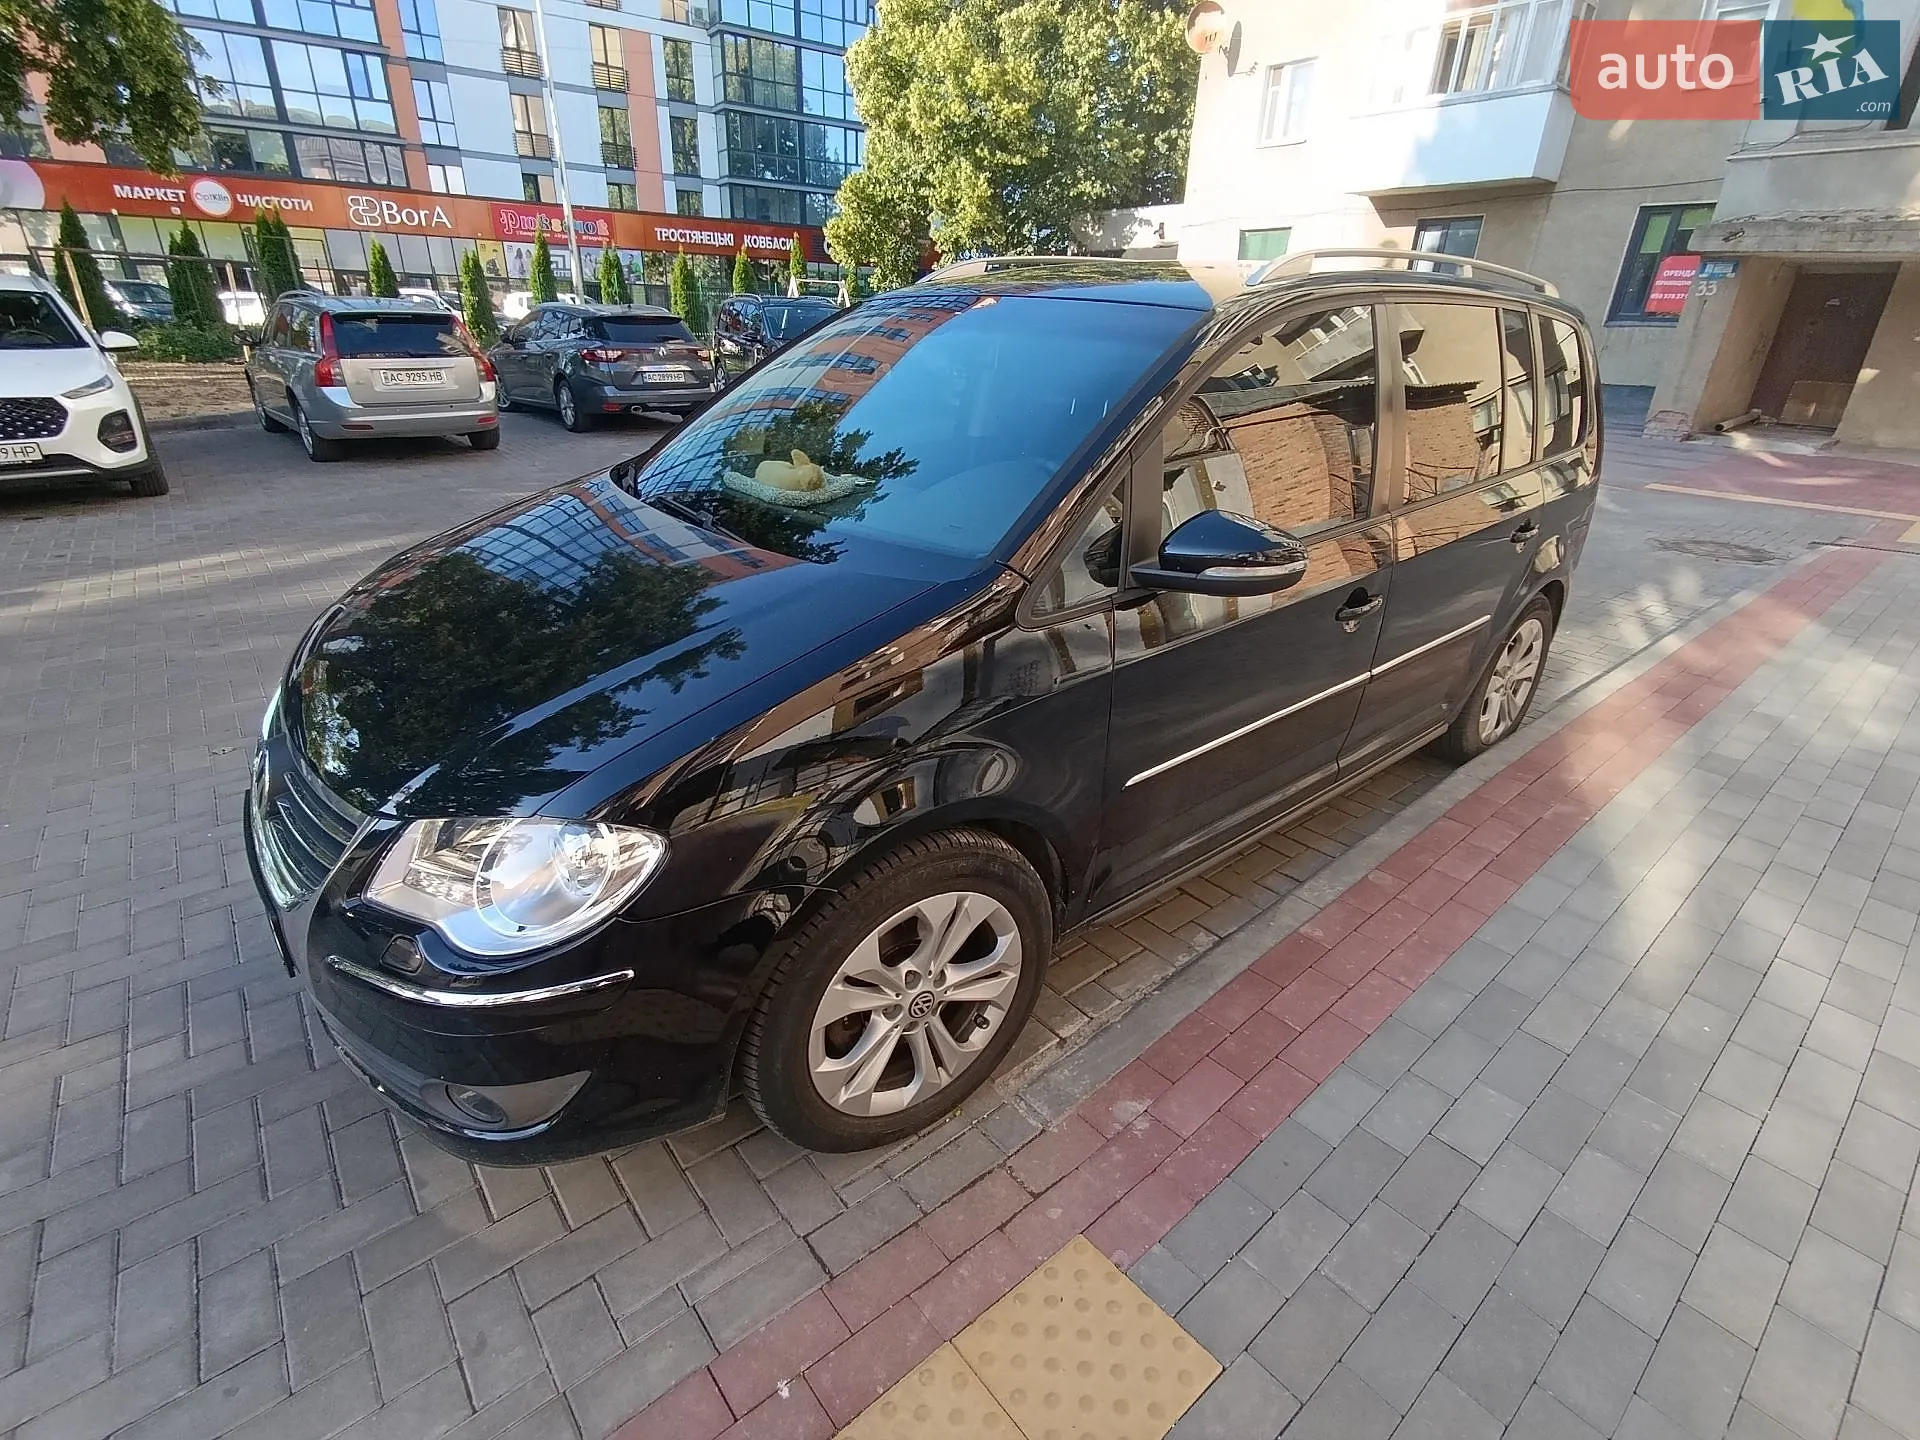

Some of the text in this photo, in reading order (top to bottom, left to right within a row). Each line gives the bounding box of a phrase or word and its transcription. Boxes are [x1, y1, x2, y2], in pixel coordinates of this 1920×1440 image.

[112, 184, 314, 212] МАРКЕТ ЧИСТОТИ
[381, 200, 452, 229] BorA
[654, 227, 794, 251] ТРОСТЯНЕЦЬКІ КОВБАСИ
[1695, 280, 1718, 297] 33
[405, 372, 427, 381] 9295
[429, 372, 443, 381] HB
[12, 445, 36, 458] HP
